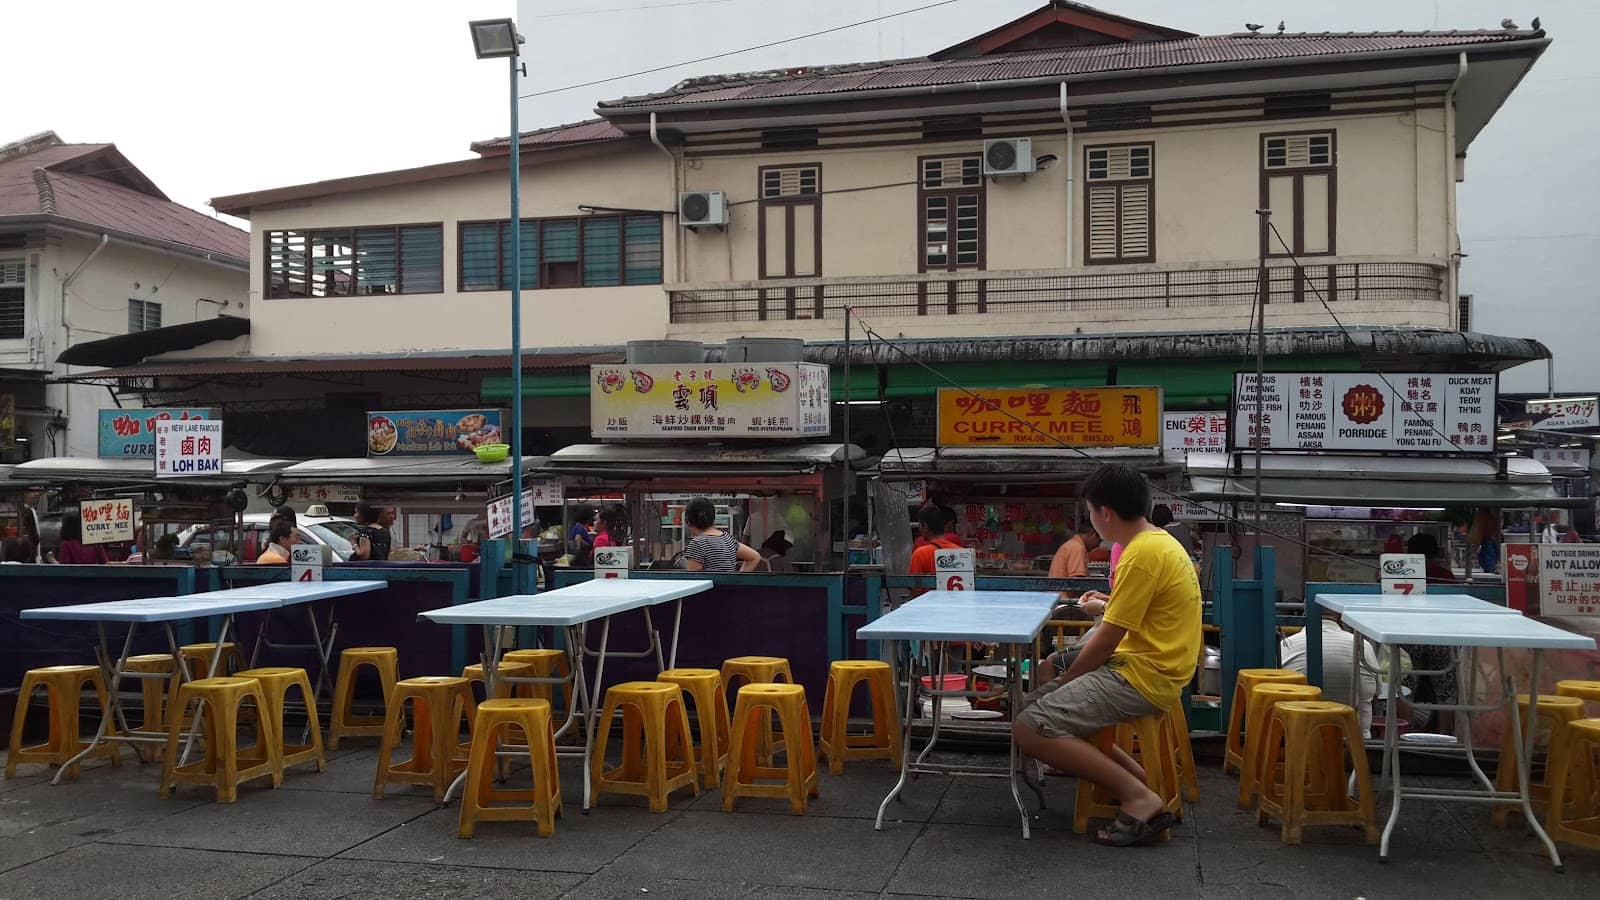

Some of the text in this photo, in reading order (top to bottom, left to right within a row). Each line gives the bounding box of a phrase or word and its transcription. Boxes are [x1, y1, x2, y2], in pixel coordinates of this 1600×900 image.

[1448, 377, 1493, 385] DUCK MEAT
[1299, 388, 1323, 399] 馳名
[1407, 389, 1431, 400] 馳名
[1460, 387, 1481, 395] KOAY
[672, 384, 718, 410] 雲頂
[1459, 396, 1481, 405] TEOW
[955, 390, 1102, 419] 咖哩麵
[1266, 403, 1282, 411] FISH
[1299, 400, 1323, 411] 叻沙
[1351, 391, 1377, 417] 粥
[1458, 406, 1482, 414] TH'NG
[1121, 394, 1143, 438] 飛鴻
[1295, 413, 1327, 421] FAMOUS
[171, 424, 183, 432] NEW
[184, 424, 199, 432] LANE
[199, 424, 220, 432] FAMOUS
[953, 420, 1103, 434] CURRY MEE
[1166, 420, 1186, 430] ENG
[1296, 422, 1326, 430] PENANG
[1403, 419, 1434, 427] FAMOUS
[1457, 422, 1482, 433] 鴨肉
[1297, 431, 1324, 439] ASSAM
[1339, 428, 1388, 439] PORRIDGE
[1404, 428, 1434, 437] PENANG
[1298, 440, 1323, 448] LAKSA
[1396, 438, 1442, 446] YONG TAU FU
[172, 459, 219, 472] LOH BAK
[86, 521, 129, 531] CURRY MEE
[1546, 559, 1566, 570] NOT
[298, 568, 313, 582] 4
[946, 575, 965, 591] 6
[1393, 583, 1414, 595] 7
